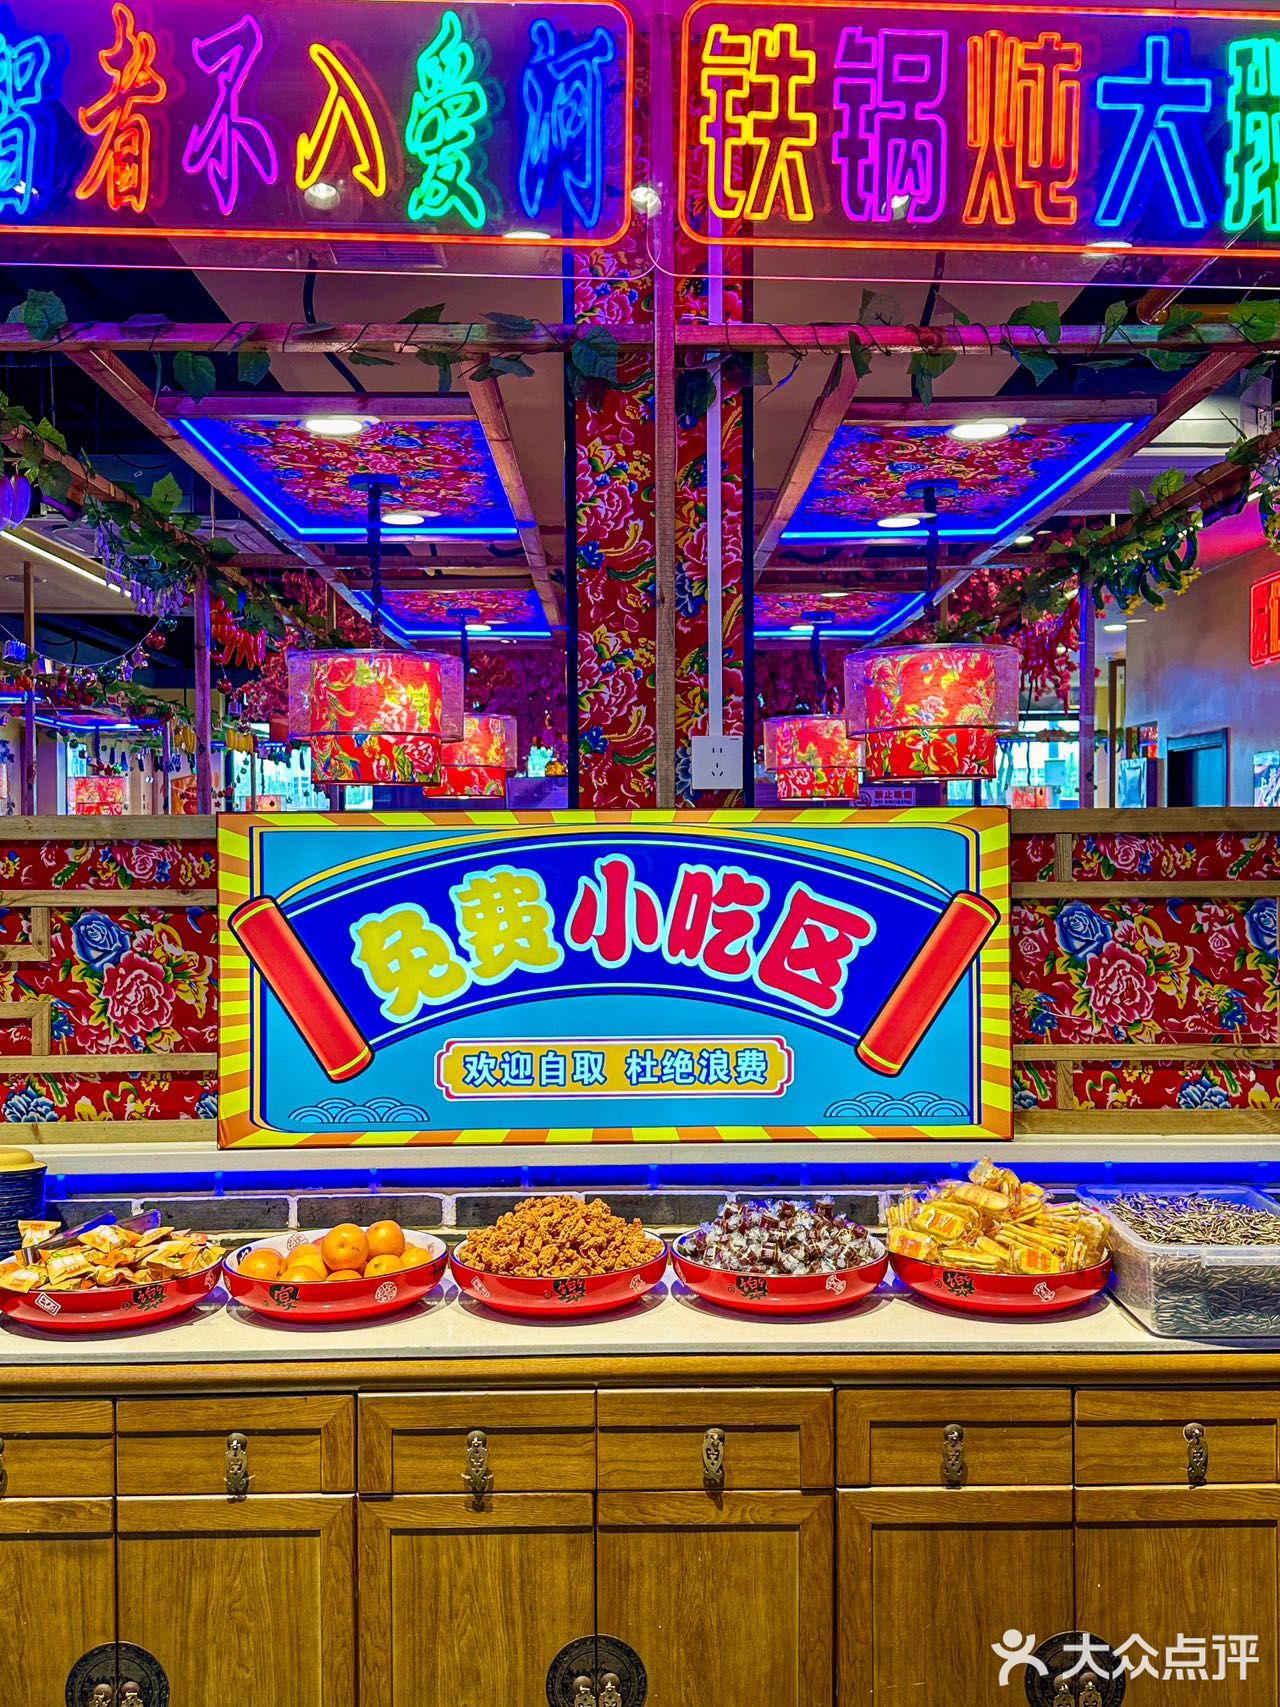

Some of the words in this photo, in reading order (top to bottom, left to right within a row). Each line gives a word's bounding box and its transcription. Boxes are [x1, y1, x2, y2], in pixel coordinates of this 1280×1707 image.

[351, 854, 876, 1020] 免费小吃区
[463, 1050, 608, 1087] 欢迎自取
[625, 1049, 769, 1085] 杜绝浪费
